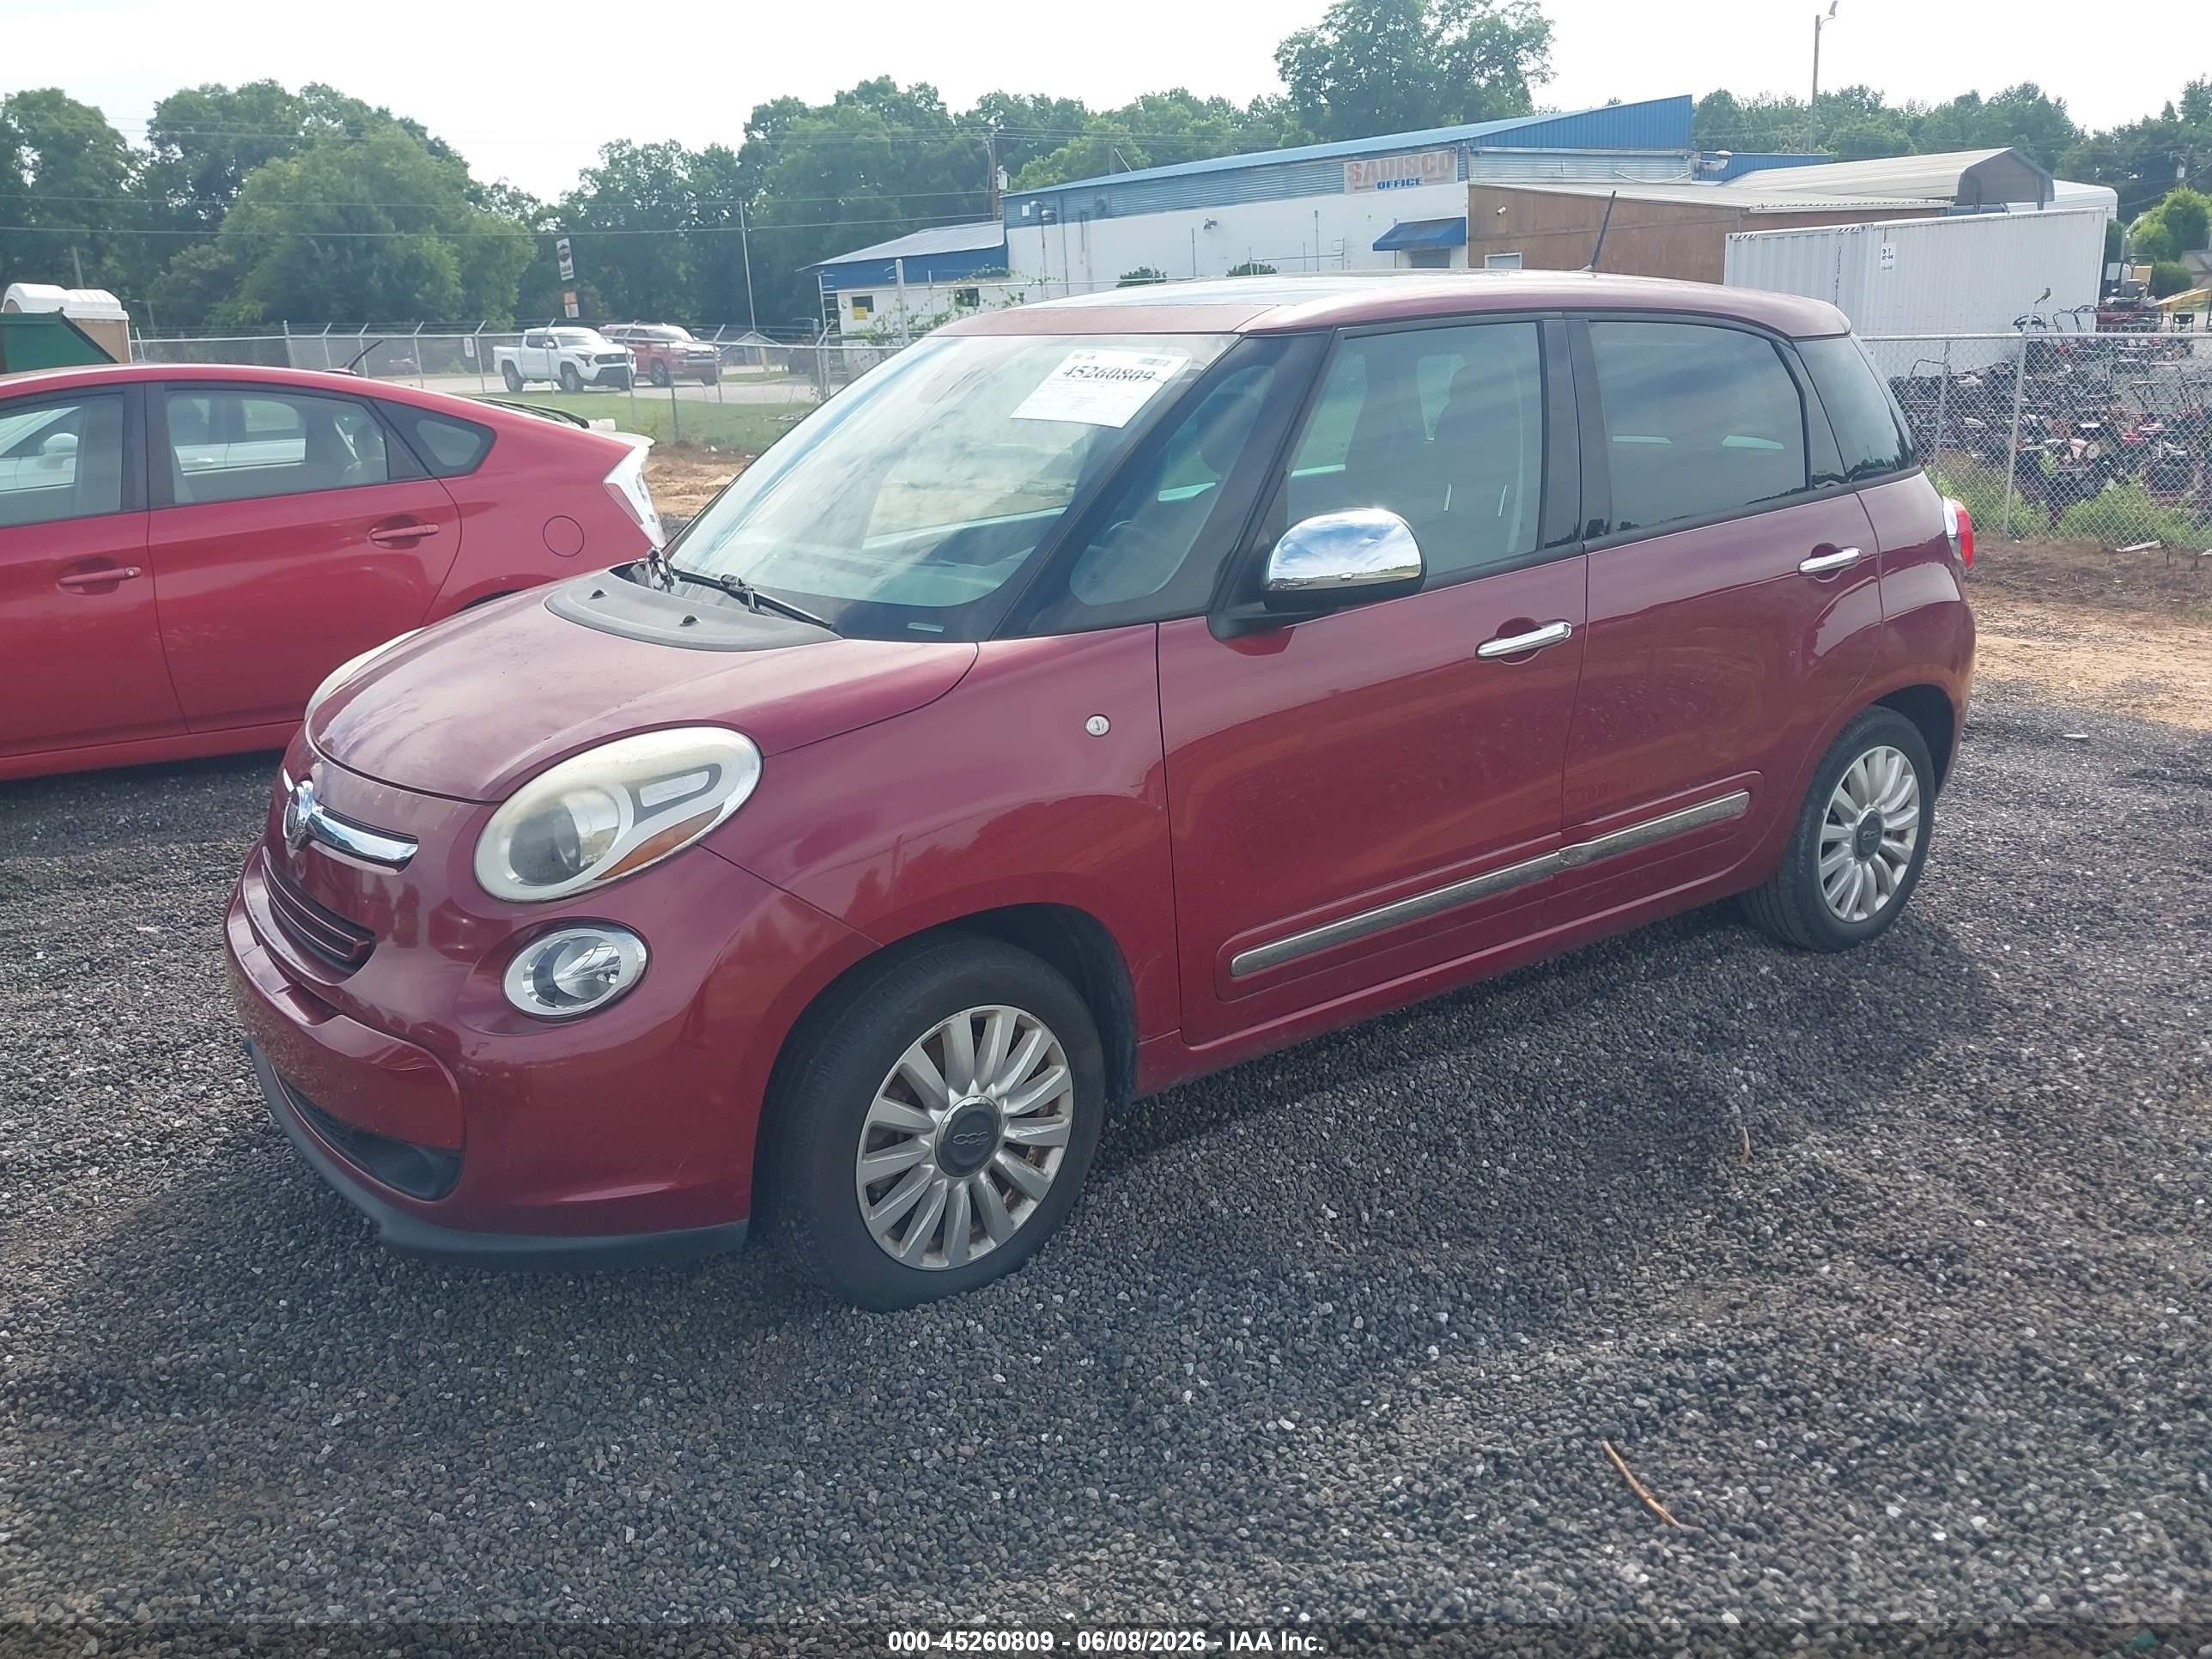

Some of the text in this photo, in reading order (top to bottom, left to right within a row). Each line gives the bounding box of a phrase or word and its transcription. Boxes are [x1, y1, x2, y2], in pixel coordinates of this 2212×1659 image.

[1347, 152, 1456, 183] SADISCO
[1376, 178, 1423, 190] OFFICE
[1063, 365, 1157, 383] 45260809
